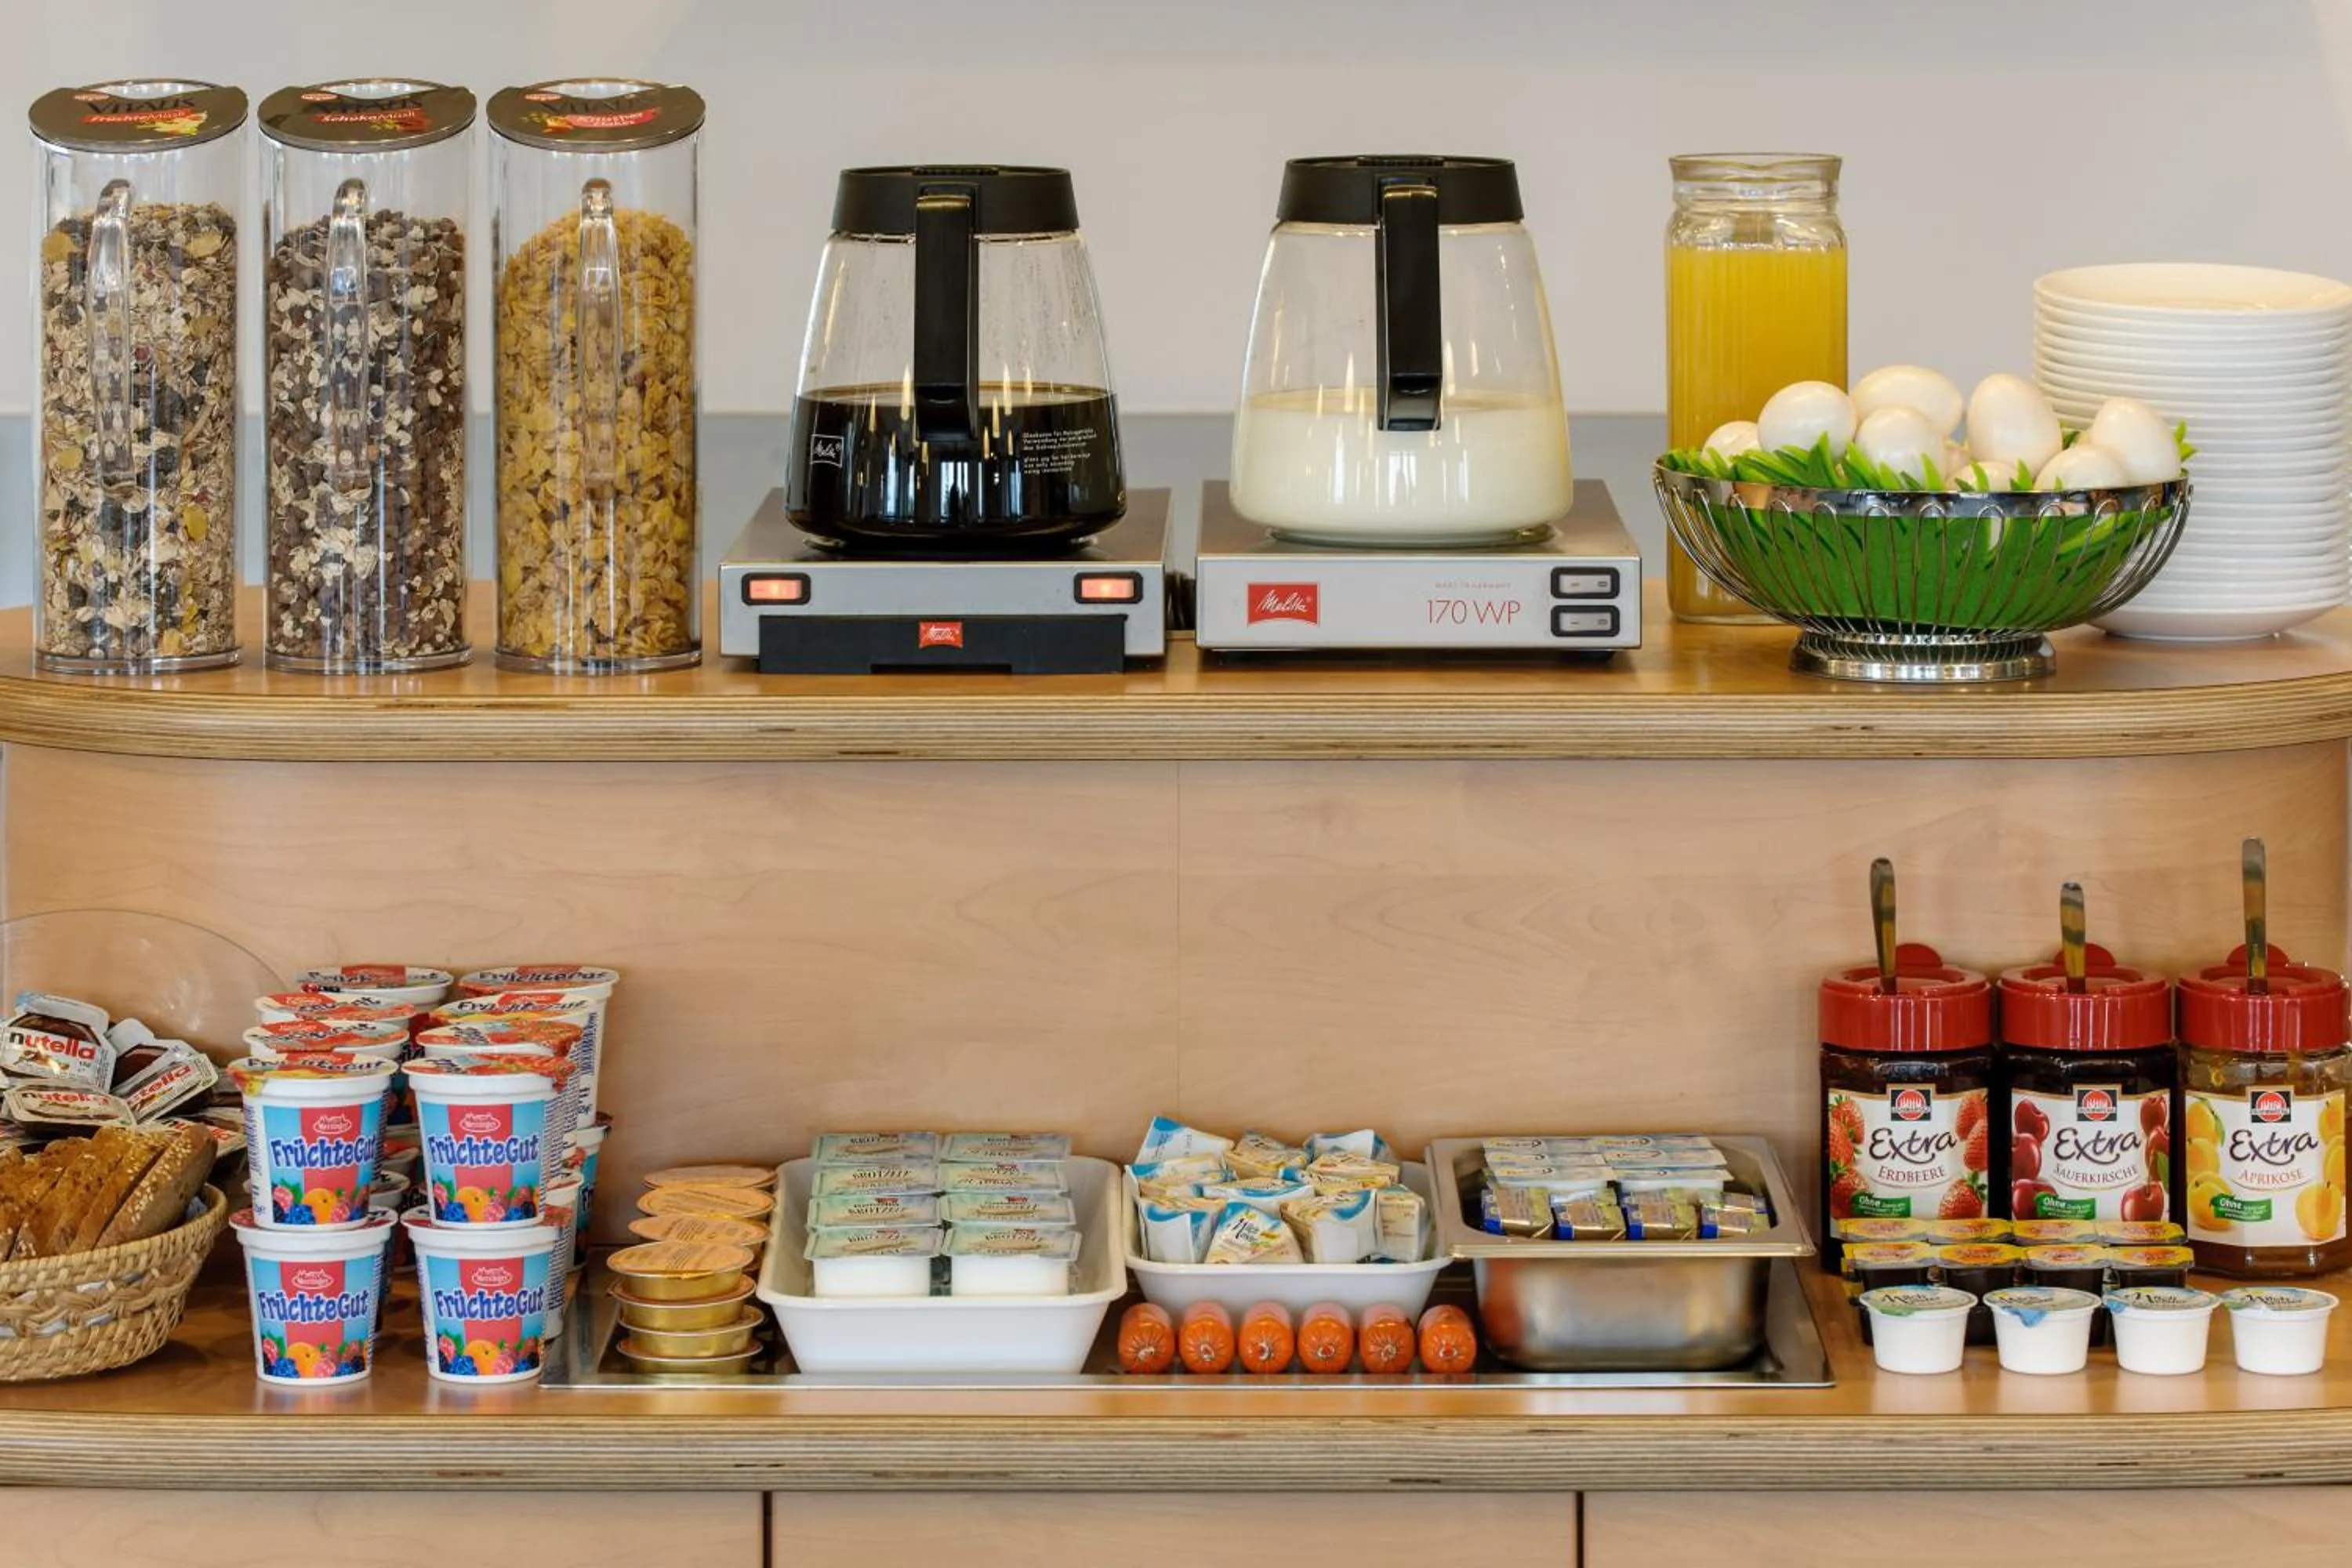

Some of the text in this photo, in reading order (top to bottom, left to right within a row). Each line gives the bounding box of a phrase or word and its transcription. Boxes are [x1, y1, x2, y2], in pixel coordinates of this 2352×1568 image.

[1254, 589, 1308, 614] Melitta
[1427, 600, 1521, 625] 170 WP
[9, 1032, 96, 1060] nutella
[270, 1137, 377, 1168] FrüchteGut
[427, 1135, 539, 1166] FrüchteGut
[1868, 1127, 1958, 1165] Extra
[2053, 1127, 2142, 1165] Extra
[2229, 1129, 2319, 1167] Extra
[1877, 1165, 1947, 1184] ERDBEERE
[2053, 1163, 2140, 1184] SAUERKIRSCHE
[2240, 1167, 2306, 1185] APRIKOSE
[258, 1290, 369, 1322] FrüchteGut
[434, 1287, 545, 1319] FrüchteGut
